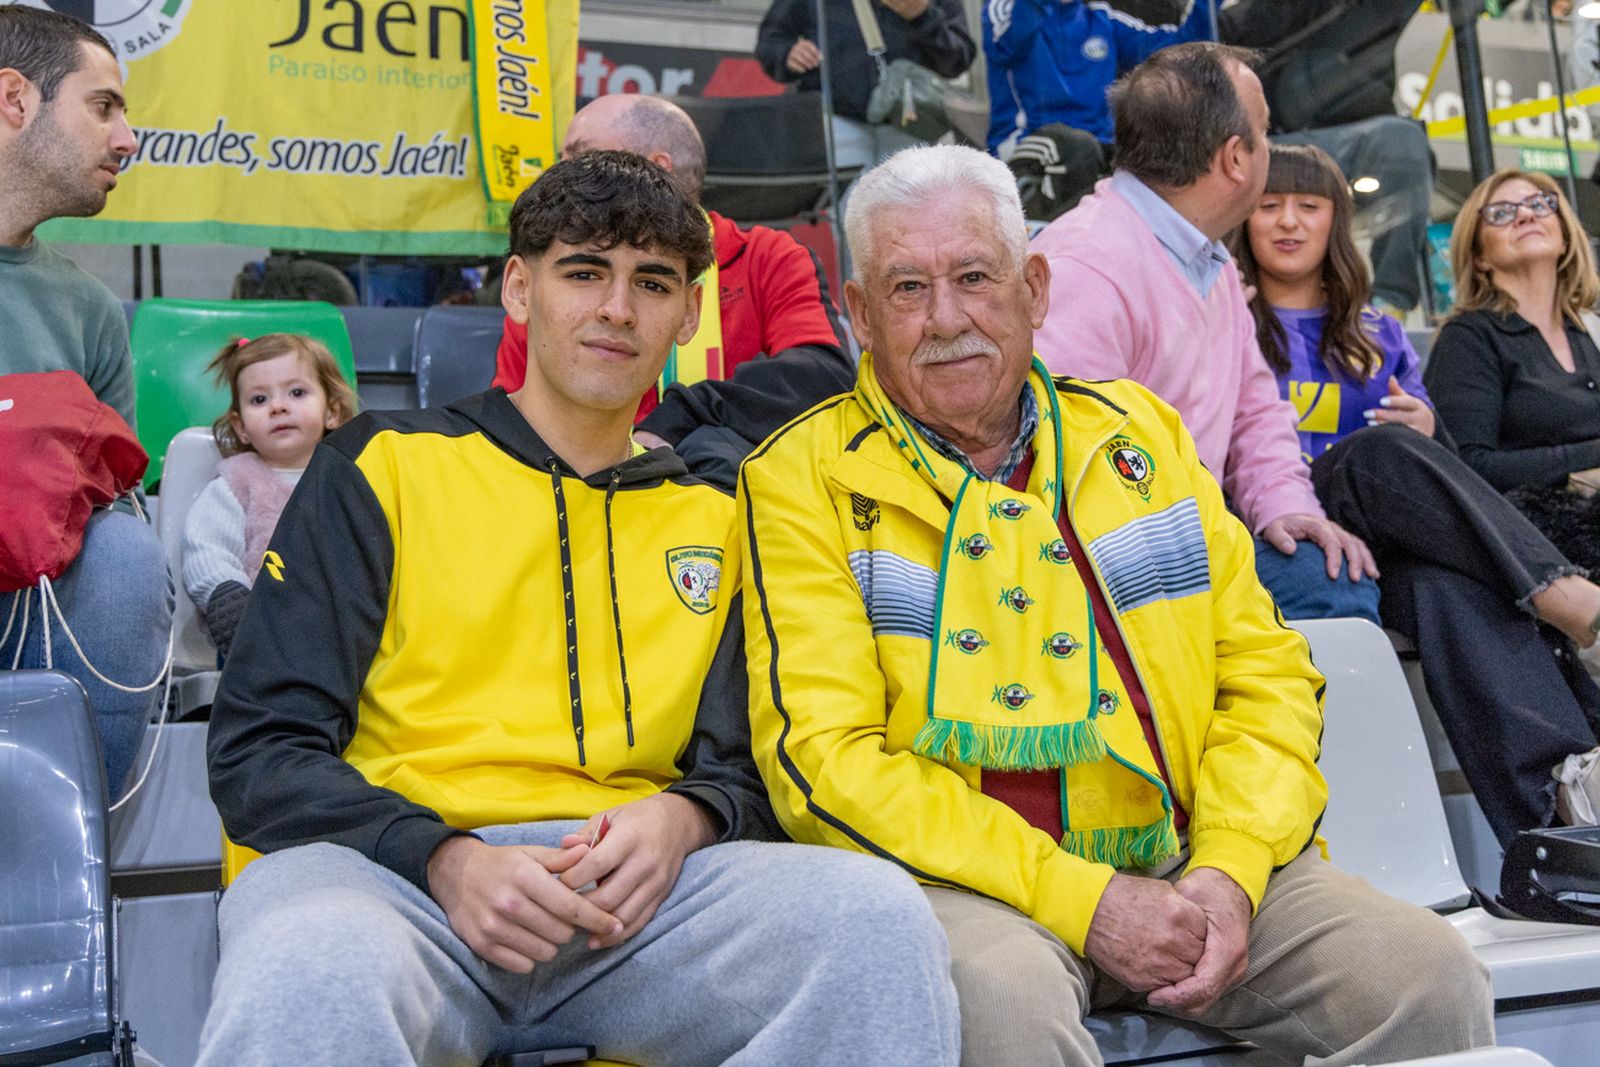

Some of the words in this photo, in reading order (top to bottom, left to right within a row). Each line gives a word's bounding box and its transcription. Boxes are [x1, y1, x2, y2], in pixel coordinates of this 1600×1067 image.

[124, 22, 171, 53] SALA
[497, 45, 540, 119] Jaén!
[578, 50, 694, 96] tor
[267, 139, 380, 174] somos
[382, 132, 468, 176] Jaén!
